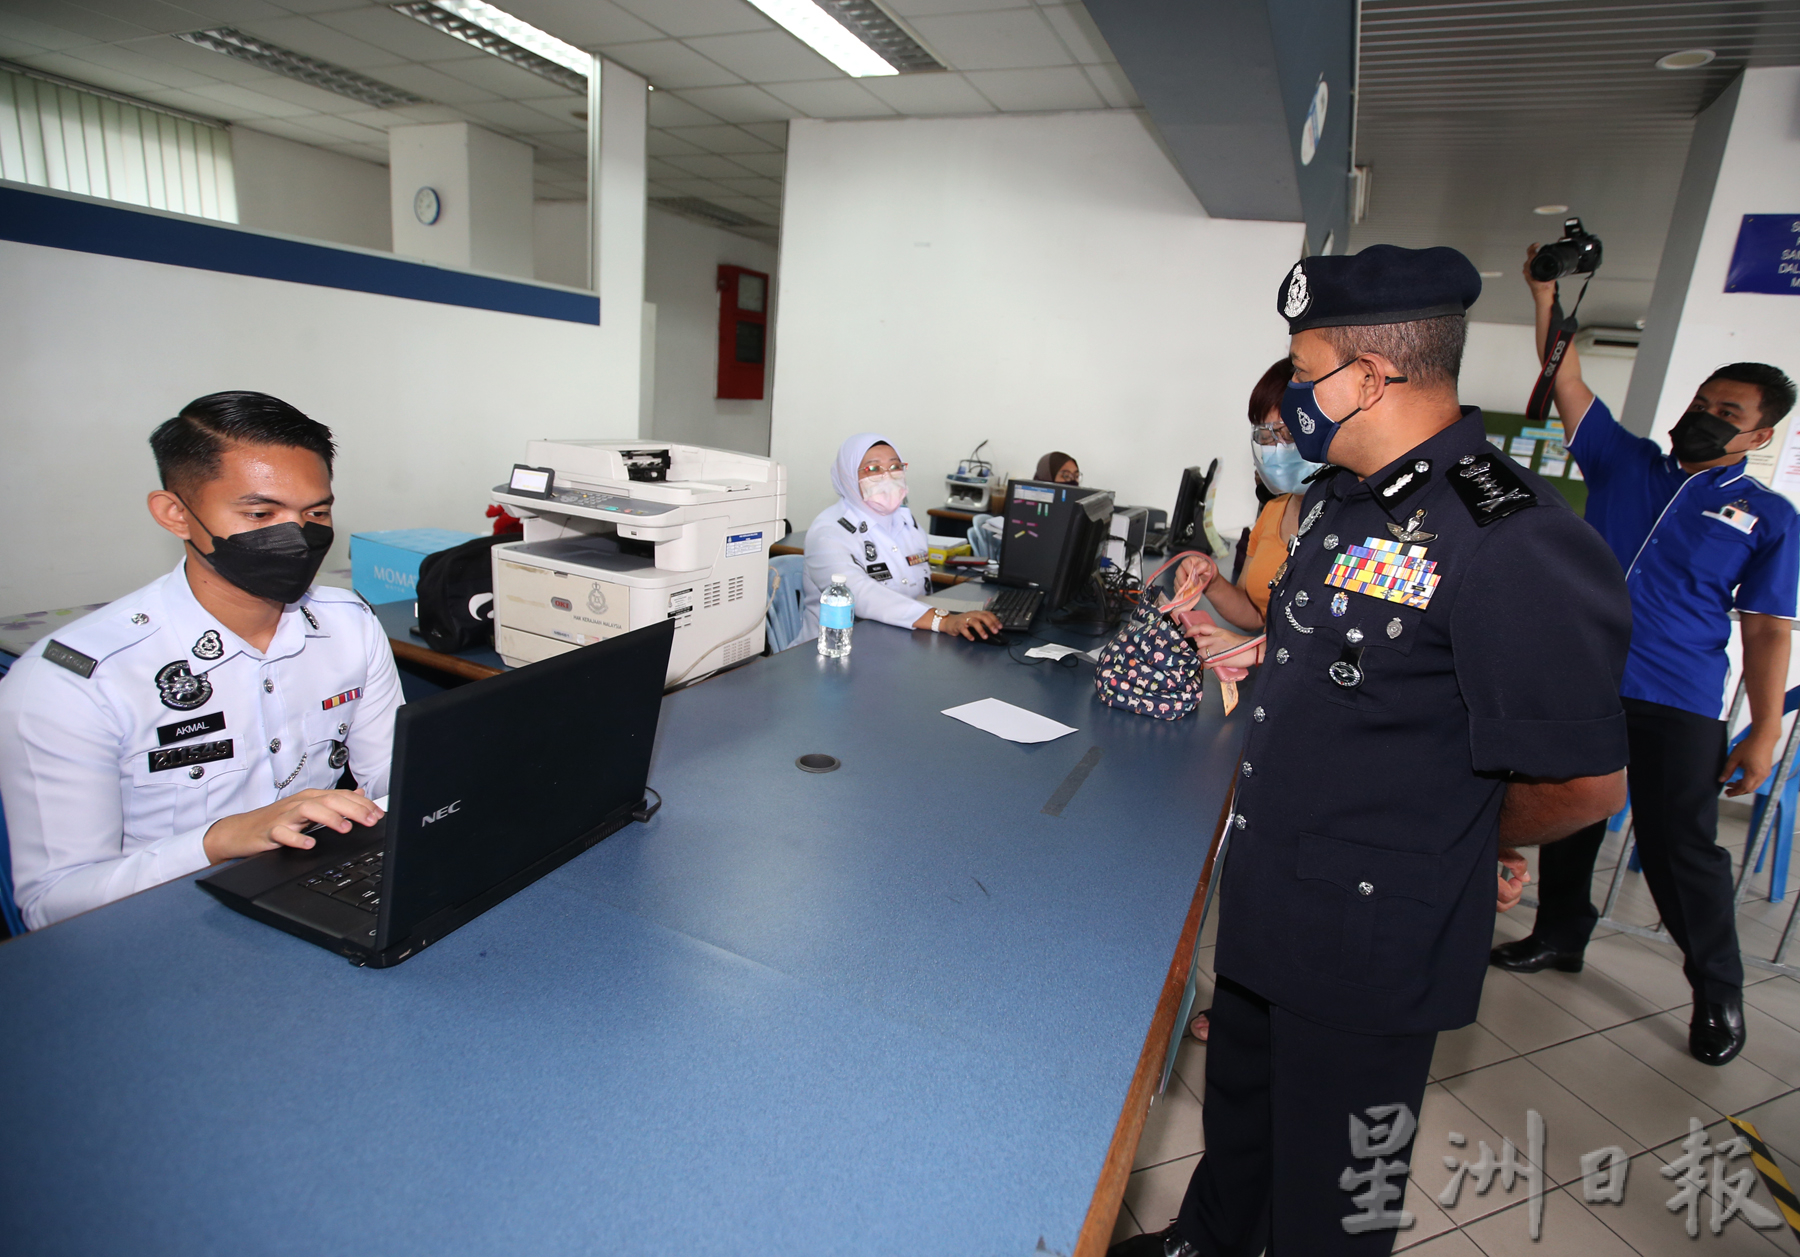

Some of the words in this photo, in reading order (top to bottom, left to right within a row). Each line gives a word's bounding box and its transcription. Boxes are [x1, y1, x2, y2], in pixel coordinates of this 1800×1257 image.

[1551, 341, 1566, 361] EOS
[373, 565, 416, 590] MOMA
[554, 600, 569, 609] OKI
[176, 722, 209, 736] AKMAL
[421, 799, 462, 828] NEC
